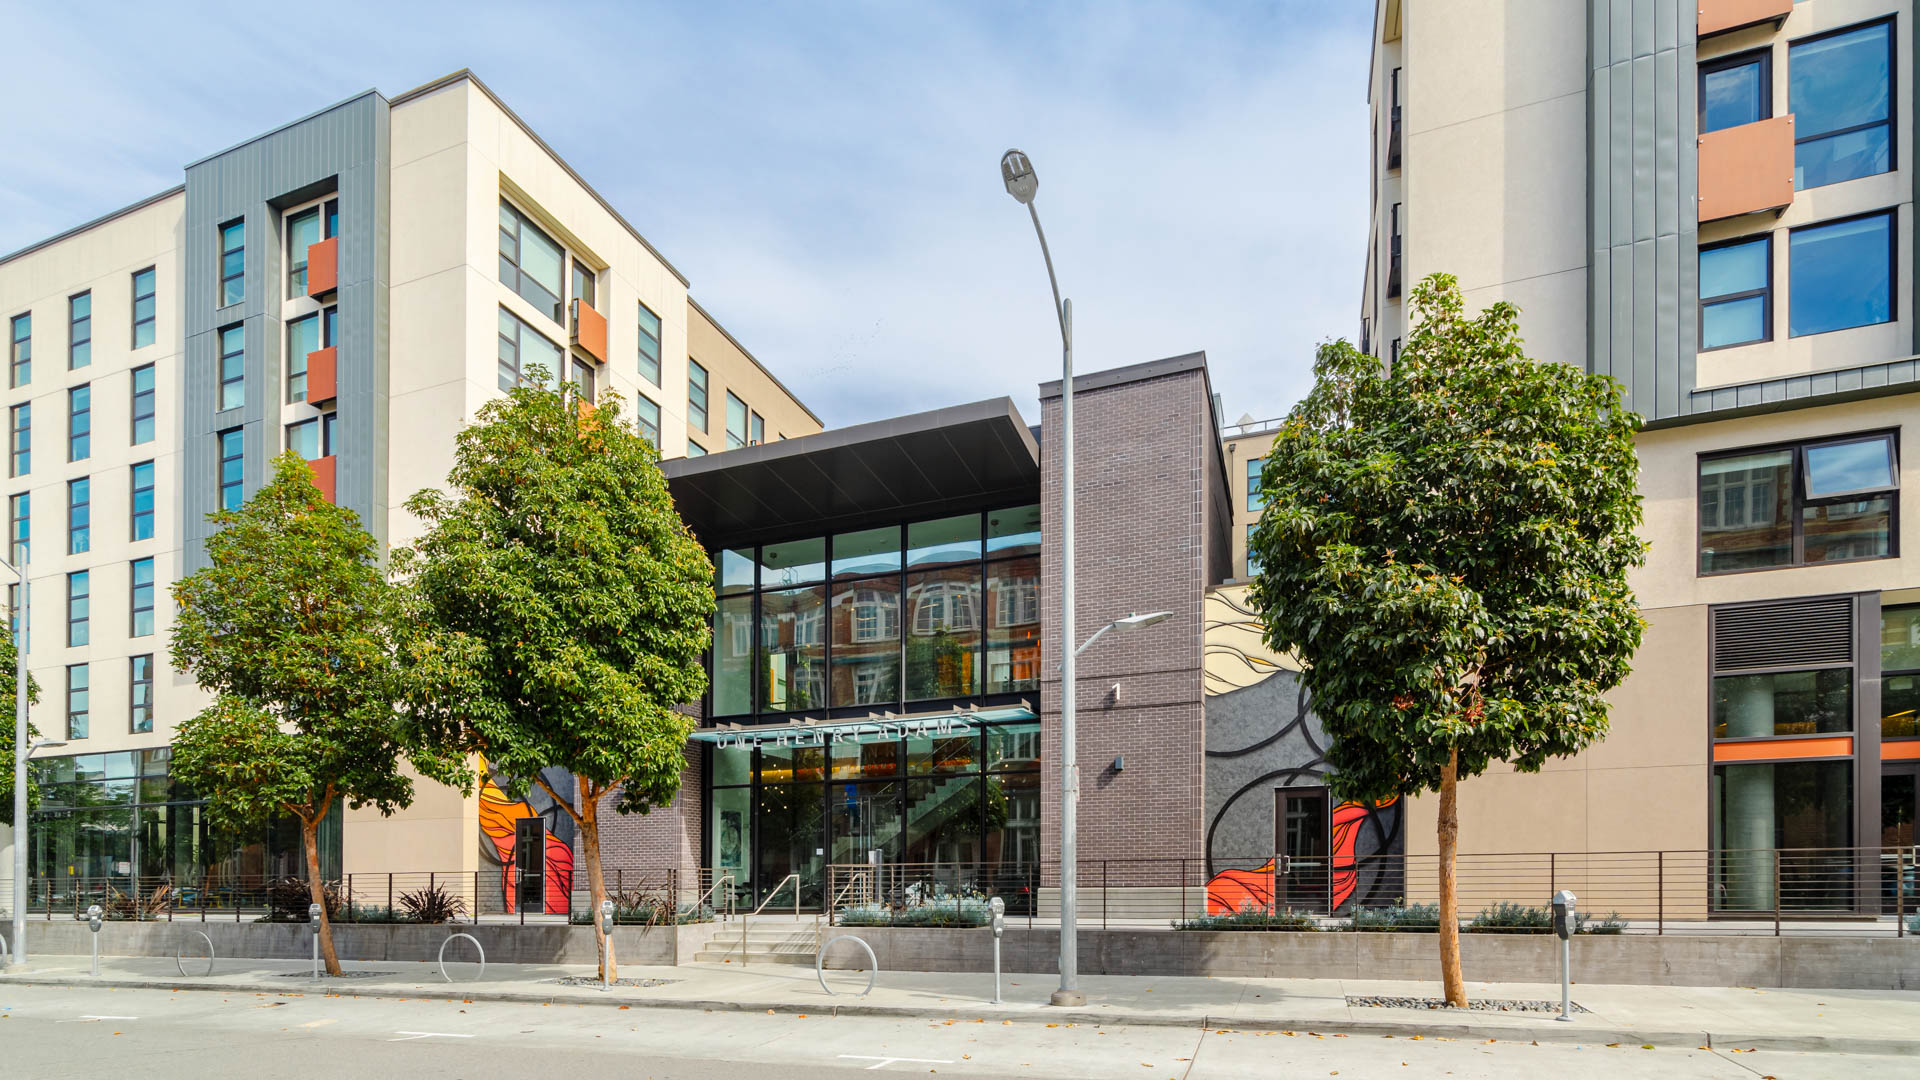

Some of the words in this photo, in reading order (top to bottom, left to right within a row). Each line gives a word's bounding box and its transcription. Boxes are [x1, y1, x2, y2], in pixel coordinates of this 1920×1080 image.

[717, 732, 762, 749] ONE
[776, 725, 861, 746] HENRY
[878, 718, 971, 739] ADAMS
